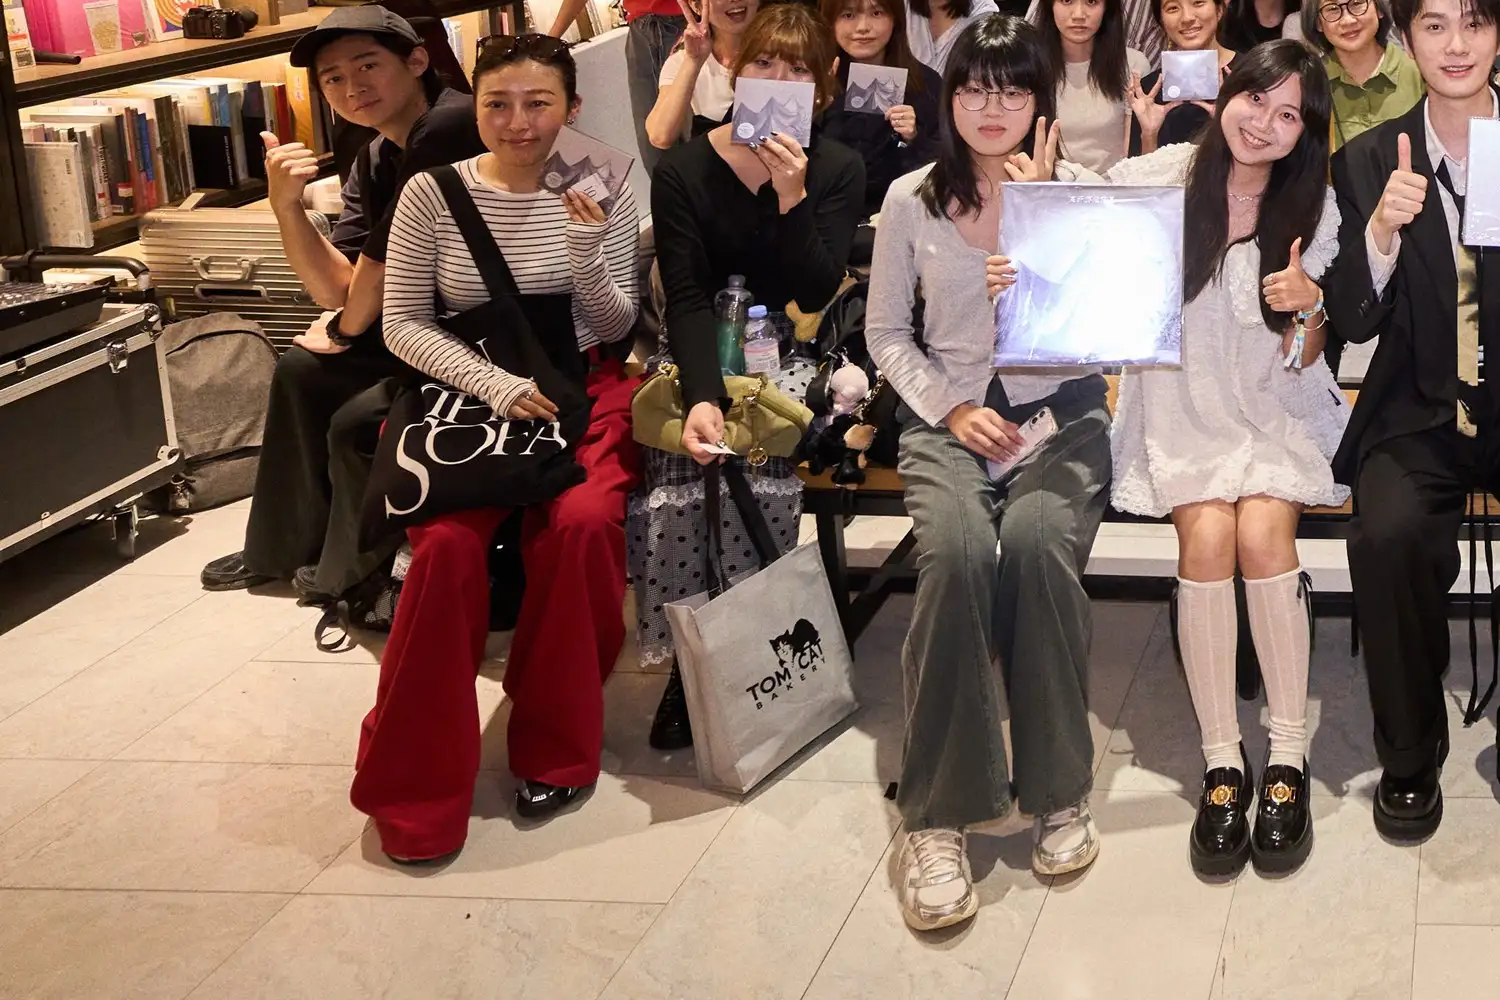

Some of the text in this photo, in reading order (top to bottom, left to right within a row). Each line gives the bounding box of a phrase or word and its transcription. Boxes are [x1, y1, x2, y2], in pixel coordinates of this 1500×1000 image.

[745, 638, 824, 702] TOM CAT
[756, 658, 827, 710] BAKERY
